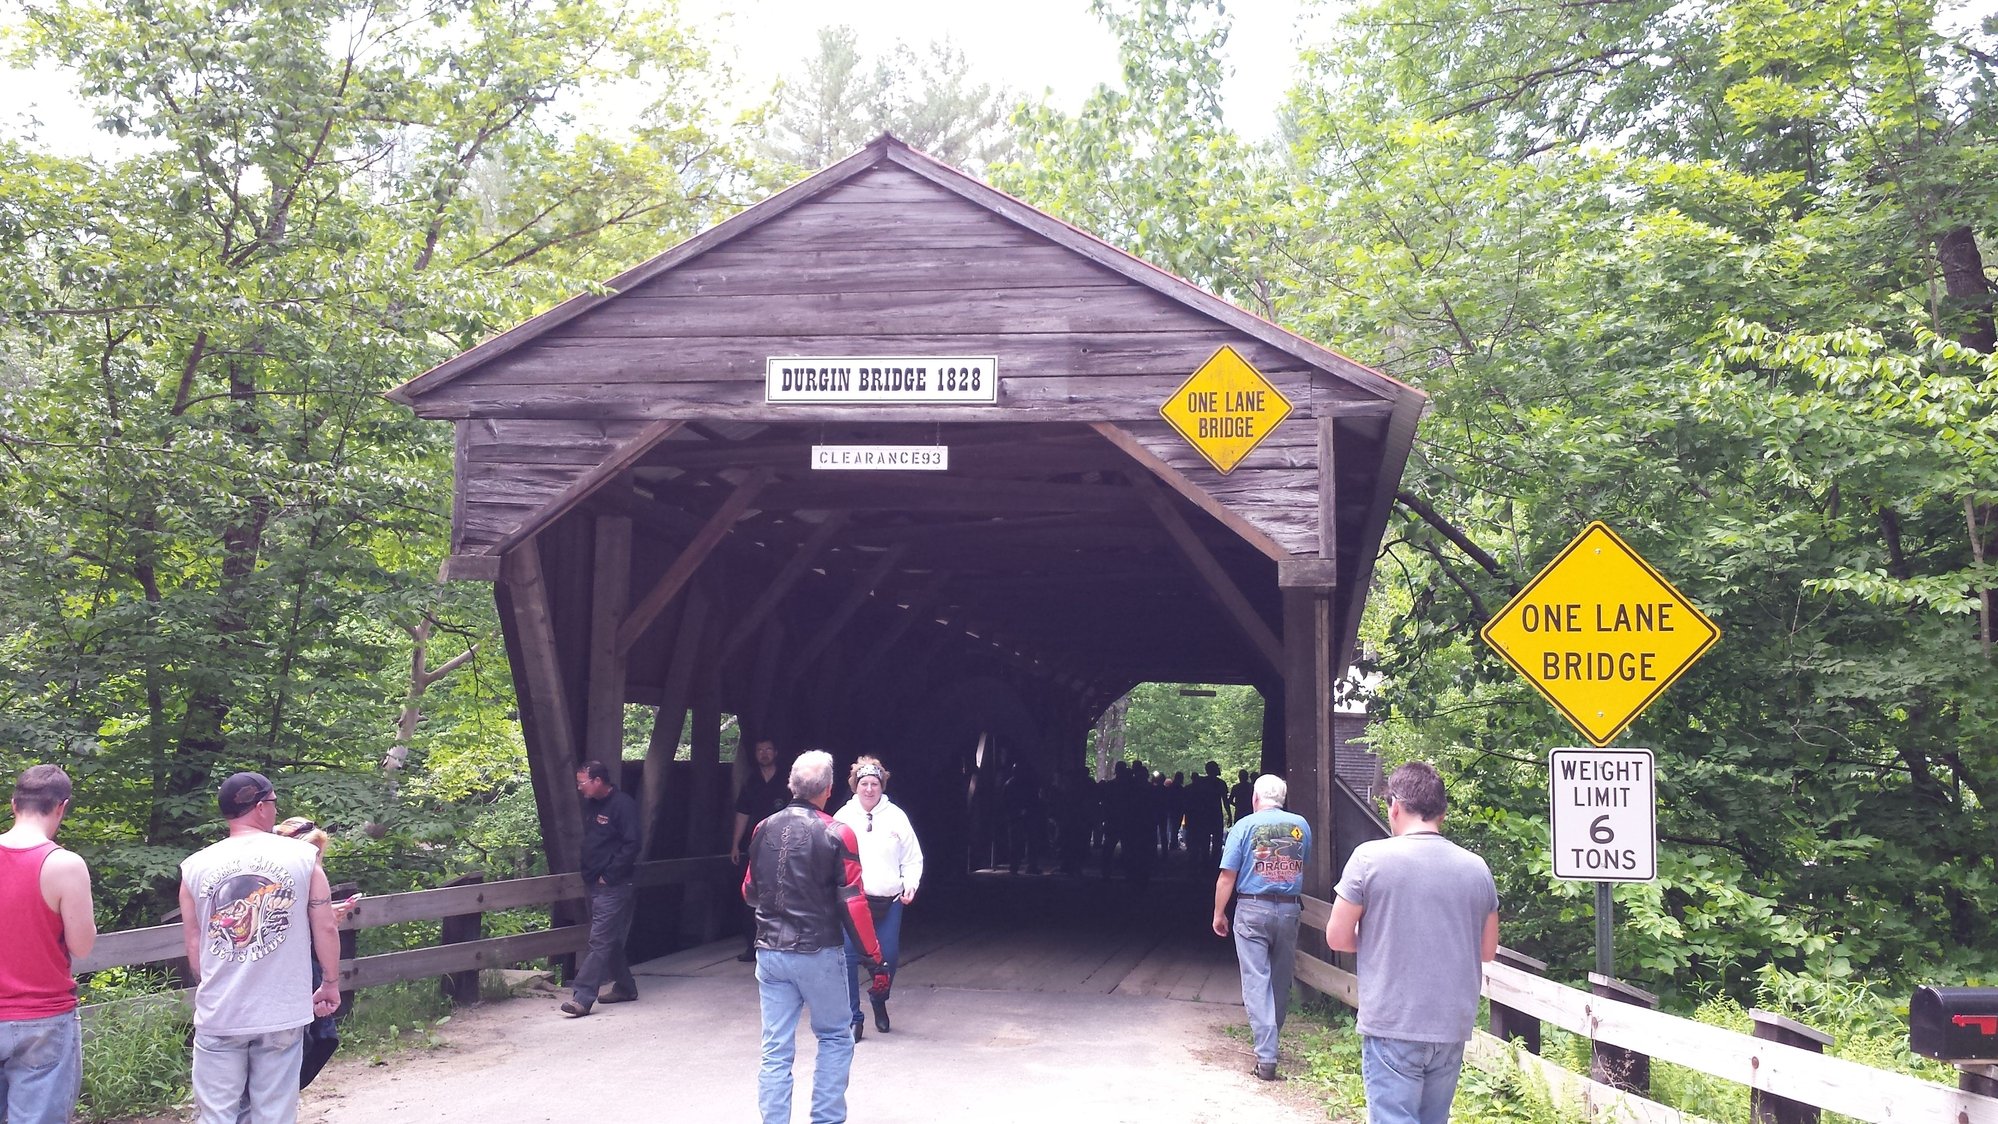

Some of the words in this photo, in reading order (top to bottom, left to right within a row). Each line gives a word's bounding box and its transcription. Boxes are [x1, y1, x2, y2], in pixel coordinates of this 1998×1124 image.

[781, 367, 850, 392] DURGIN
[858, 367, 927, 392] BRIDGE
[937, 367, 982, 392] 1828
[1188, 391, 1218, 413] ONE
[1225, 391, 1265, 412] LANE
[1199, 416, 1254, 438] BRIDGE
[1522, 603, 1582, 633] ONE
[1596, 603, 1674, 632] LANE
[1543, 652, 1656, 681] BRIDGE
[1561, 760, 1643, 781] WEIGHT
[1574, 786, 1630, 807] LIMIT
[1589, 814, 1615, 844] 6
[1571, 848, 1636, 870] TONS
